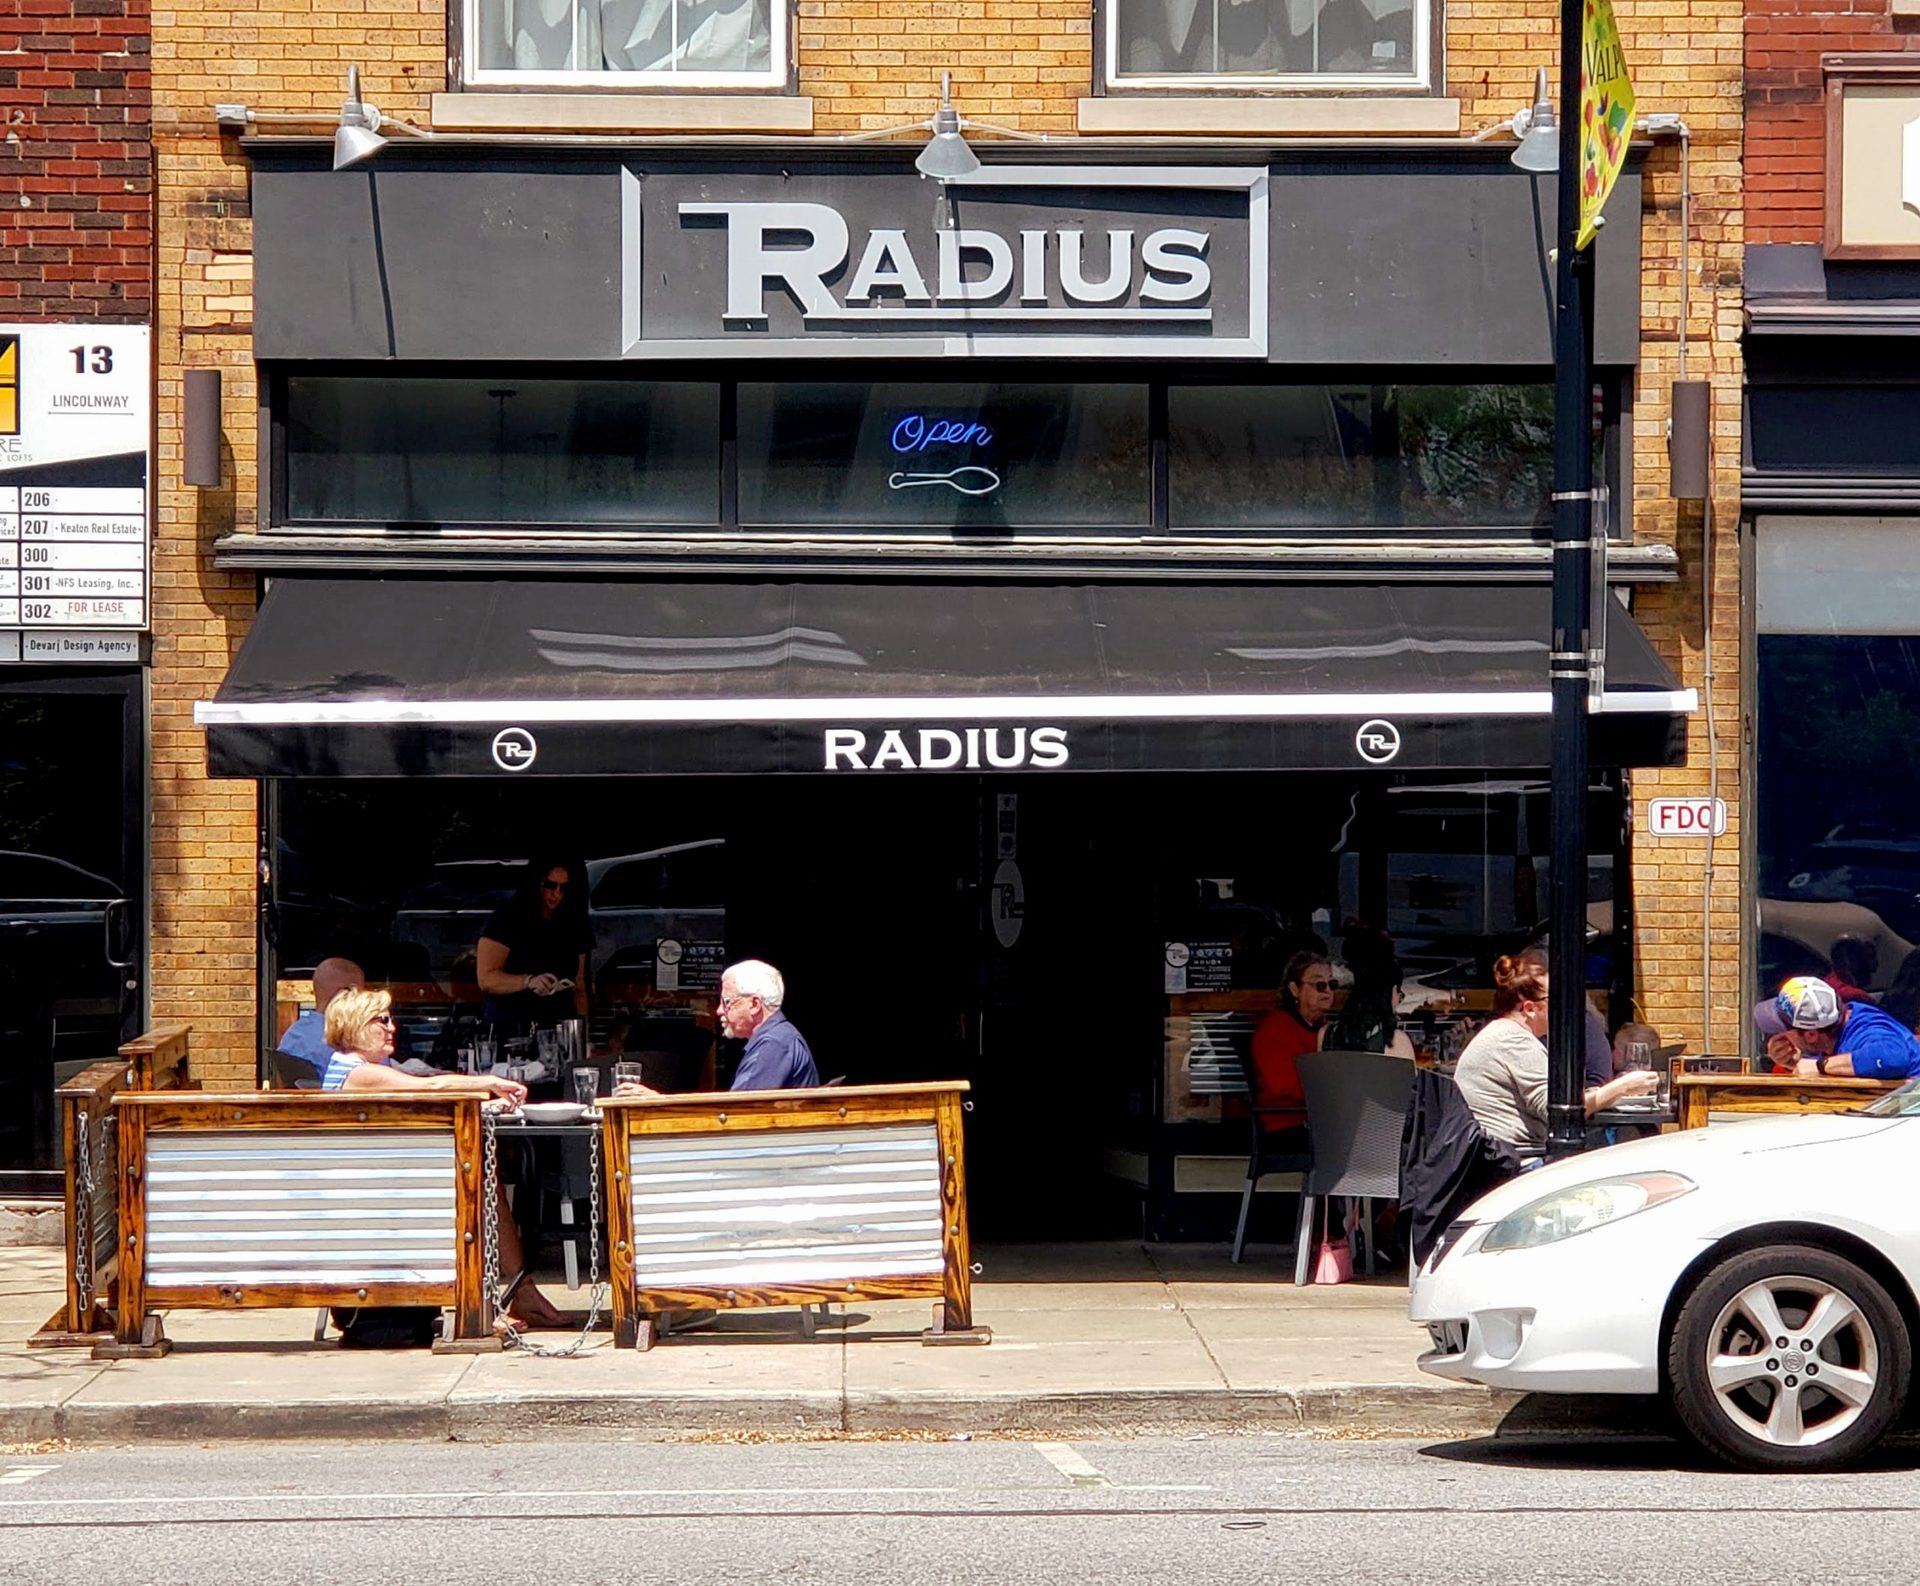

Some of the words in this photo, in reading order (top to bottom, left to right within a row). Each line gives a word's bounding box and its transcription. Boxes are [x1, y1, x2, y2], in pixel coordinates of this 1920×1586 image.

[678, 203, 1212, 319] RADIUS
[69, 345, 113, 374] 13
[53, 394, 129, 408] LINCOLNWAY
[892, 415, 993, 452] Open
[24, 492, 50, 507] 206
[24, 520, 48, 534] 207
[60, 522, 88, 533] Keaton
[91, 523, 109, 534] Real
[112, 523, 136, 534] Estate
[24, 548, 48, 562] 300
[24, 576, 50, 590] 301
[58, 578, 75, 588] NFS
[117, 579, 134, 588] Inc.
[24, 604, 51, 618] 302
[68, 602, 88, 613] FOR
[92, 602, 124, 613] LEASE
[63, 640, 94, 653] Design
[98, 640, 131, 653] Agency
[824, 727, 1069, 769] RADIUS
